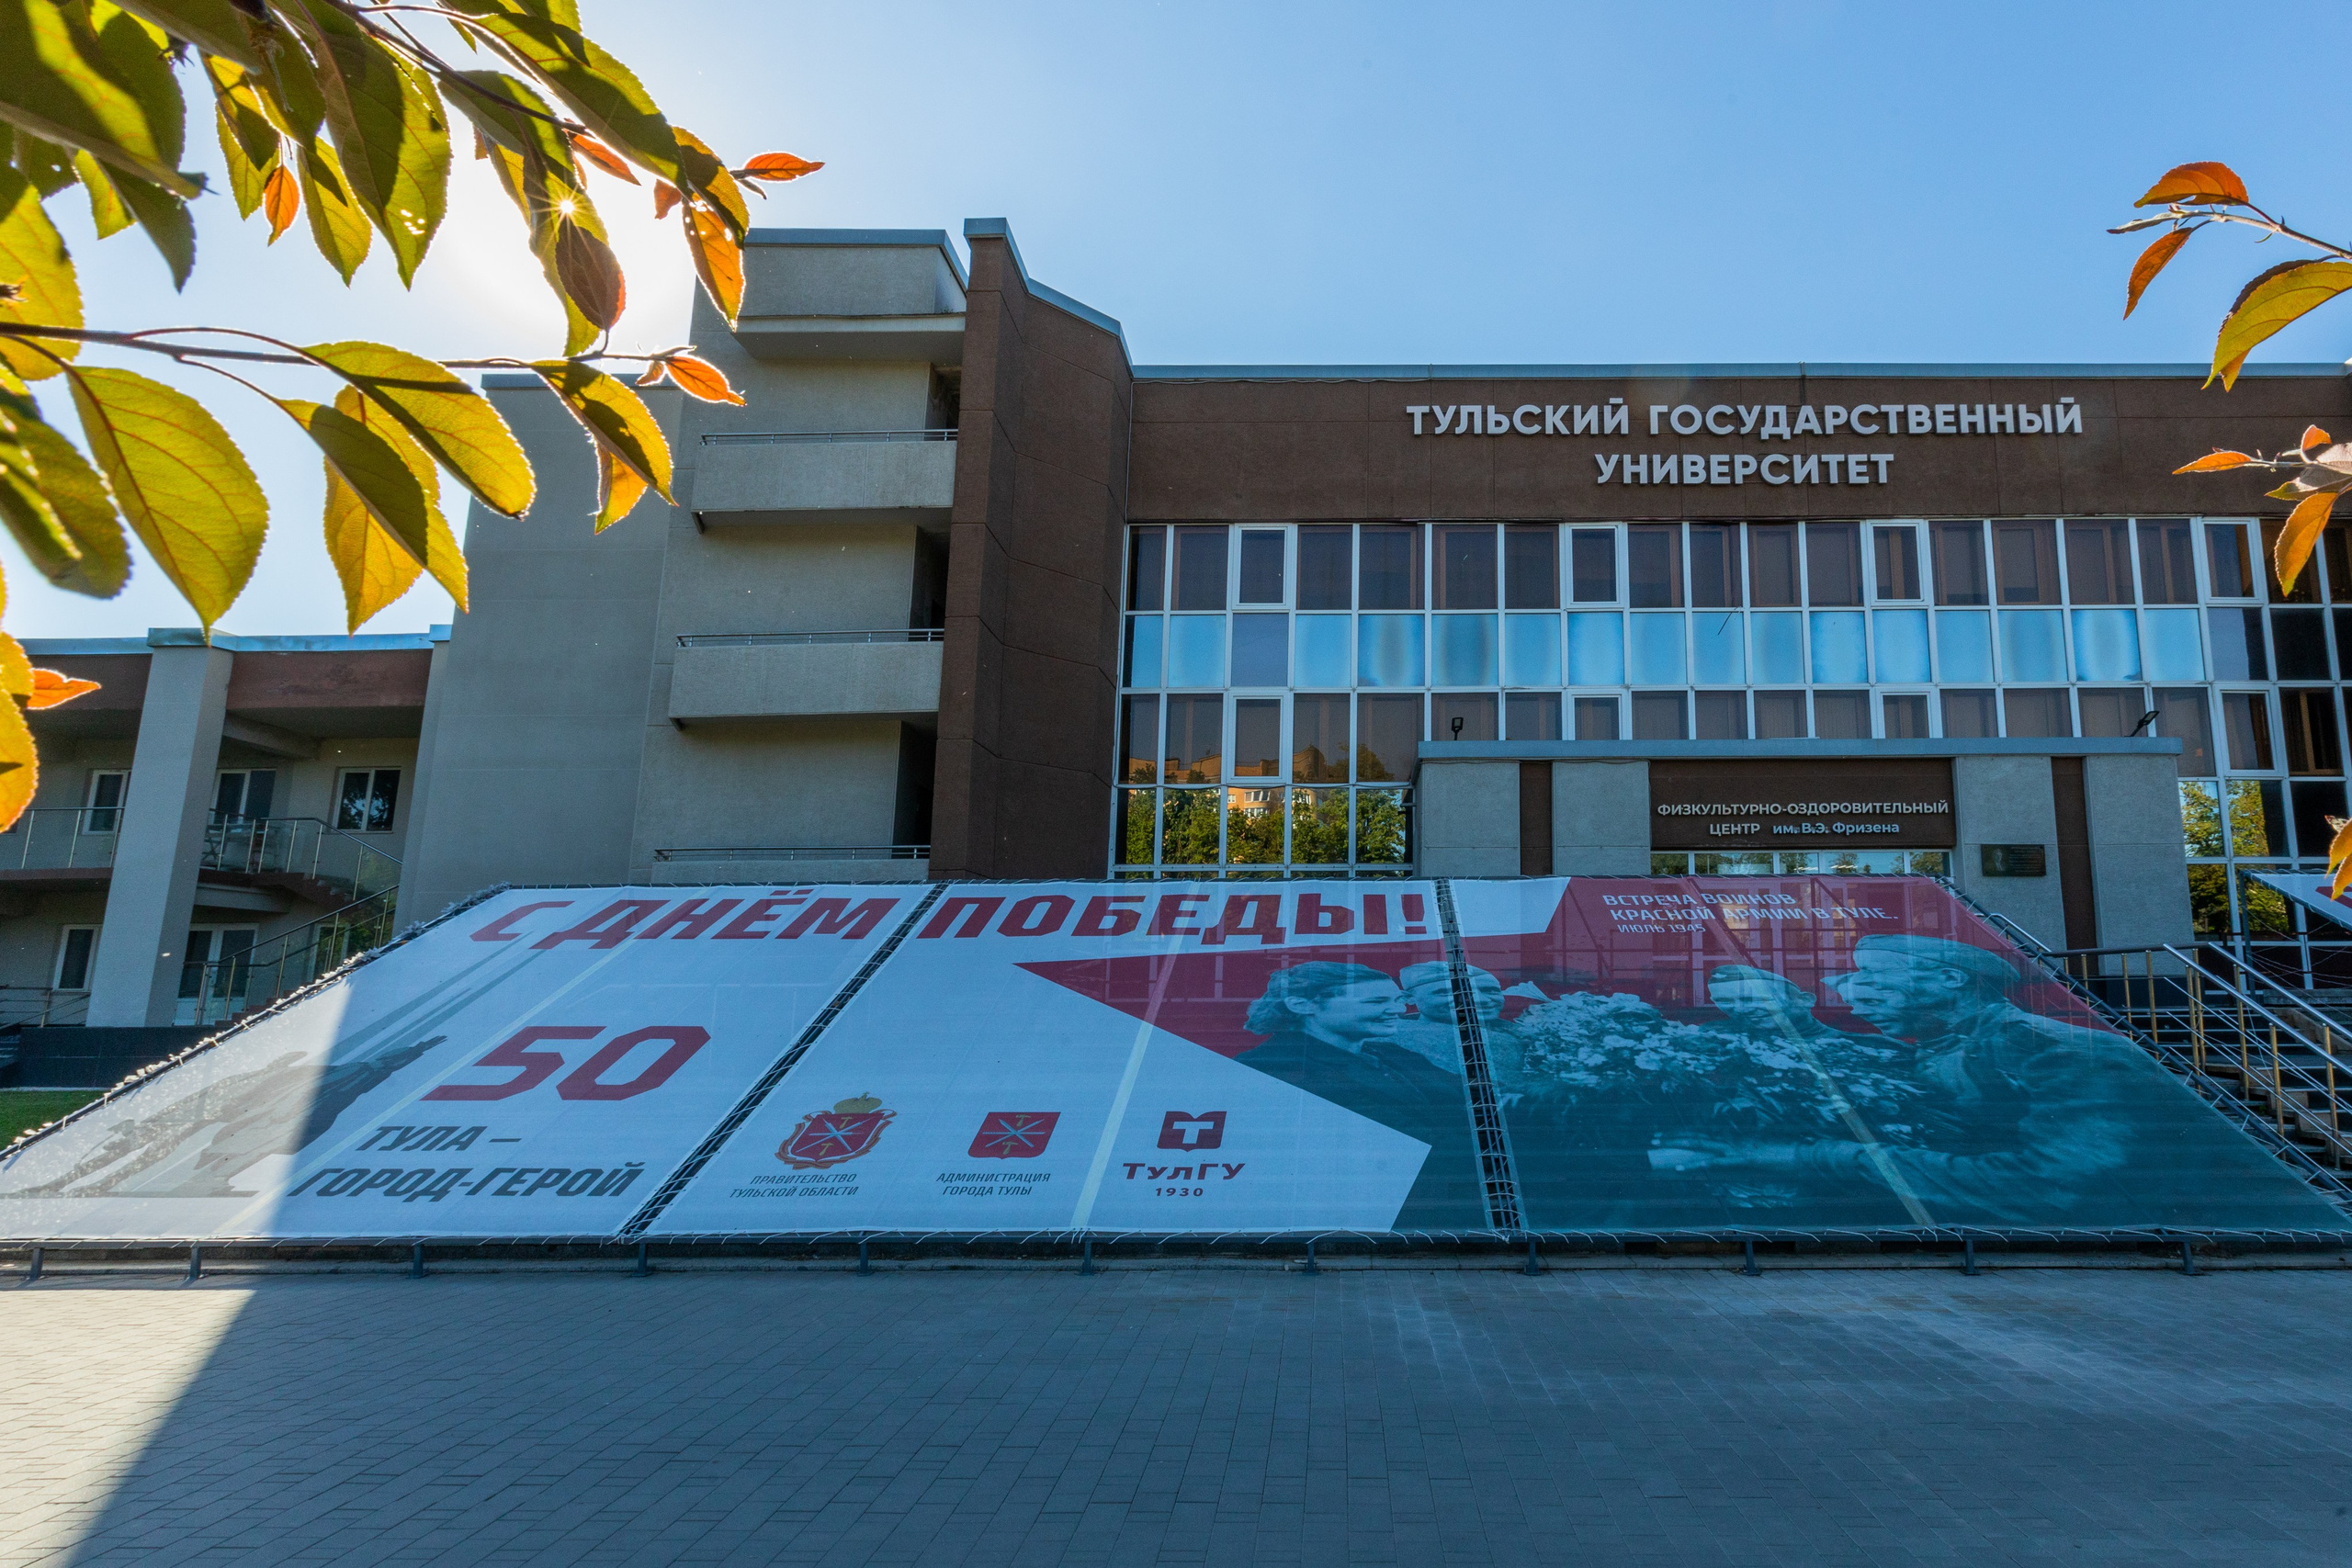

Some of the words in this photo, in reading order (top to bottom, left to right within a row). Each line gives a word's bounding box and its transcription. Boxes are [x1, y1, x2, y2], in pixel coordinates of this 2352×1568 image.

[1407, 397, 1630, 434] ТУЛЬСКИЙ
[1649, 397, 2084, 440] ГОСУДАРСТВЕННЫЙ
[1595, 454, 1894, 485] УНИВЕРСИТЕТ
[1657, 799, 1949, 817] ФИЗКУЛЬТУРНО-ОЗДОРОВИТЕЛЬНЫЙ
[1710, 822, 1760, 836] ЦЕНТР
[1832, 821, 1900, 835] Фризена
[1602, 895, 1698, 906] ВСТРЕЧА
[1700, 893, 1797, 905] ВОИНОВ
[469, 900, 574, 942] С
[528, 889, 900, 949] ДНЁМ
[915, 893, 1427, 945] ПОБЕДЫ!
[1610, 906, 1716, 920] КРАСНОЙ
[1722, 908, 1808, 919] АРМИИ
[1810, 908, 1831, 919] В
[1830, 907, 1899, 919] ТУЛЕ.
[1617, 924, 1666, 933] ИЮЛЬ
[1667, 923, 1706, 933] 1945
[418, 1025, 711, 1100] 50
[356, 1125, 488, 1151] ТУЛА
[936, 1172, 1051, 1184] АДМИНИСТРАЦИЯ
[1123, 1163, 1246, 1179] ТулГУ
[287, 1161, 645, 1202] ГОРОД-ГЕРОЙ
[750, 1173, 857, 1185] ПРАВИТЕЛЬСТВО
[729, 1186, 797, 1198] ТУЛЬСКОЙ
[798, 1186, 859, 1197] ОБЛАСТИ
[942, 1186, 994, 1197] ГОРОДА
[998, 1186, 1032, 1195] ТУЛЫ
[1155, 1187, 1204, 1197] 1930
